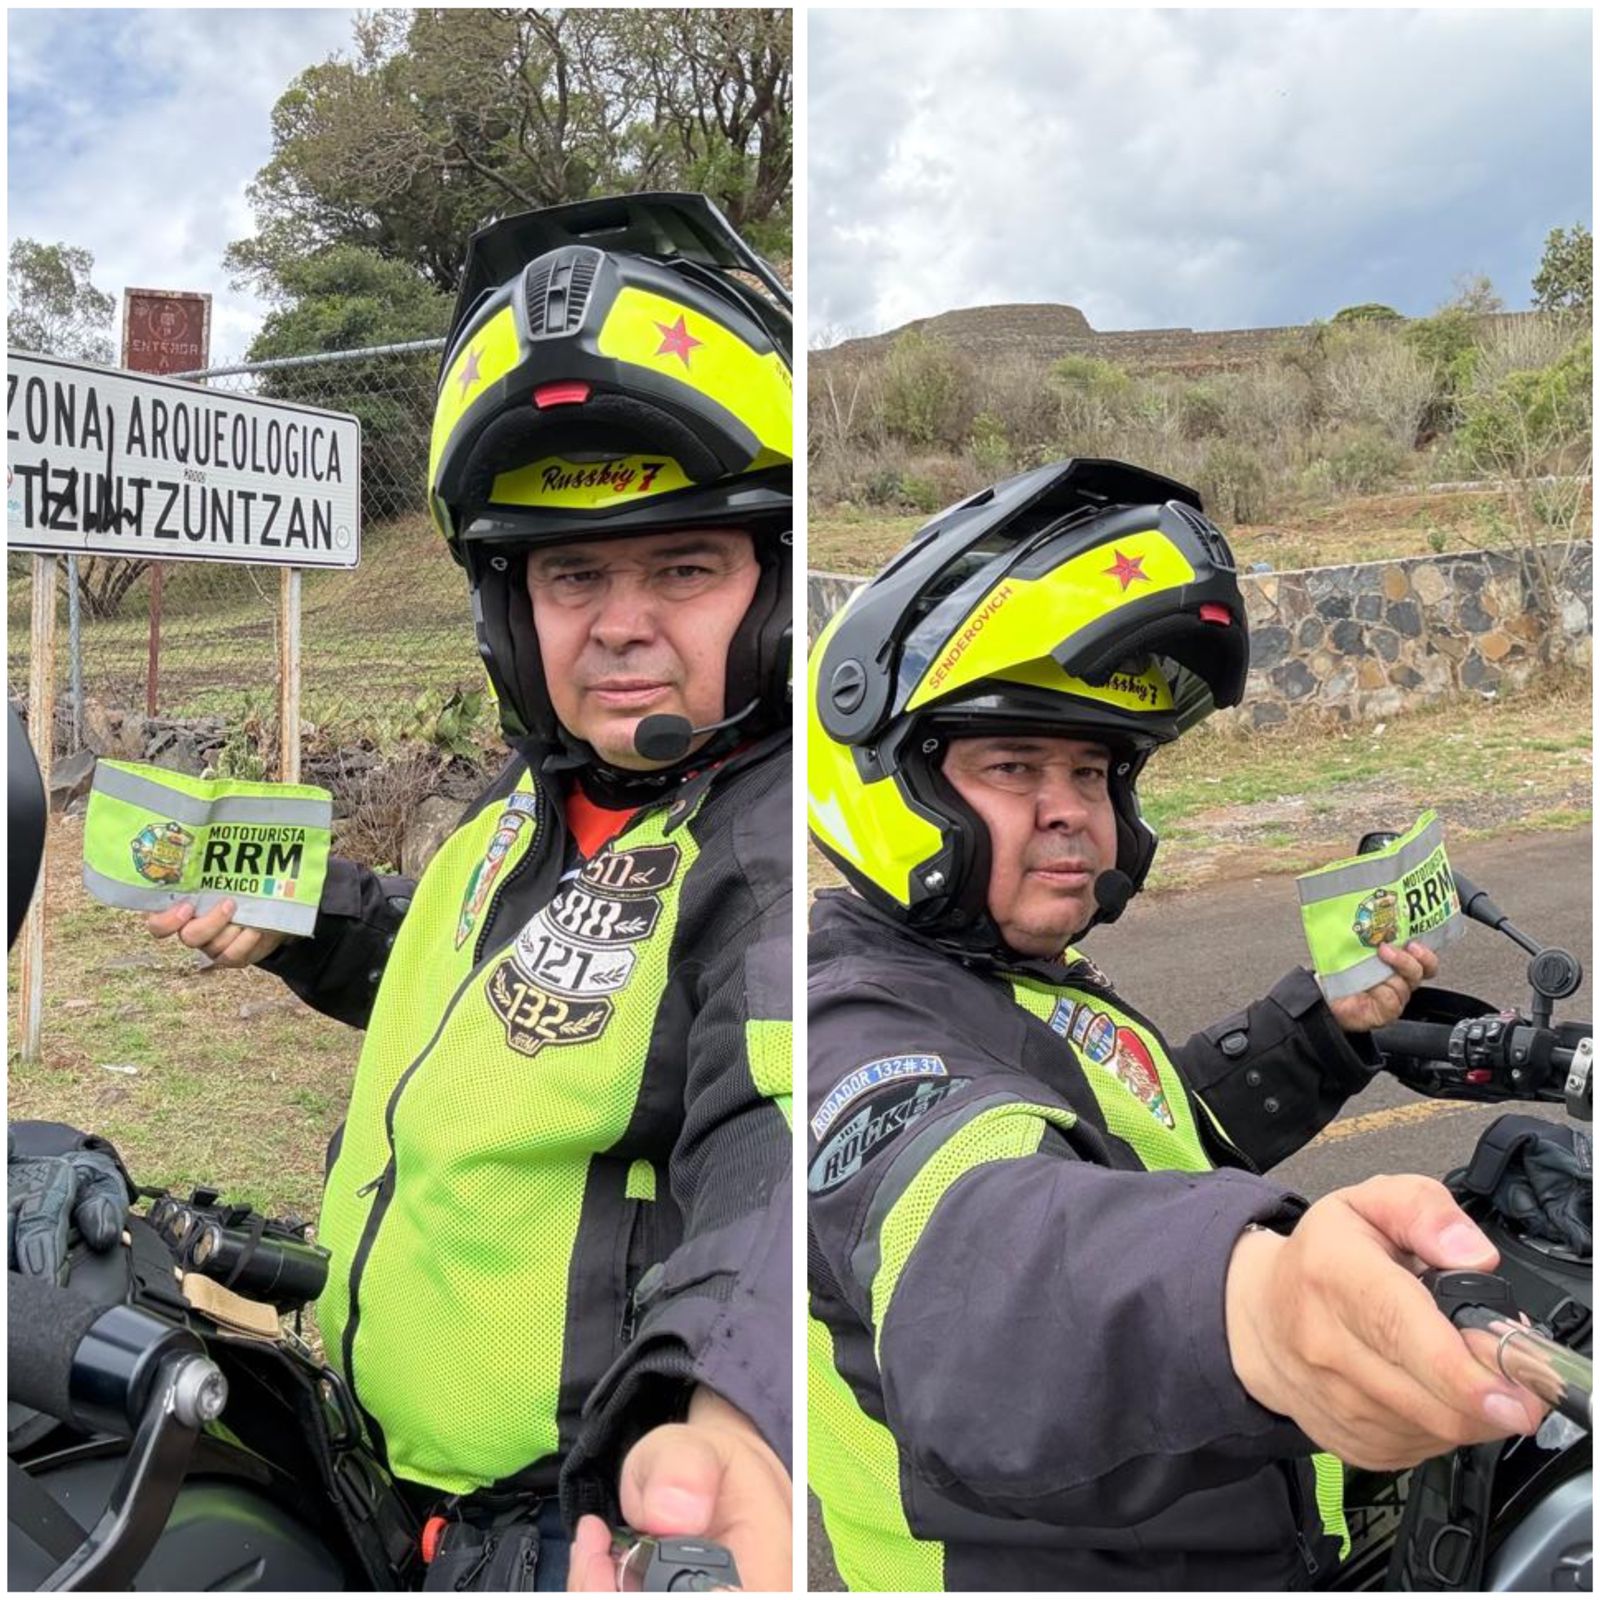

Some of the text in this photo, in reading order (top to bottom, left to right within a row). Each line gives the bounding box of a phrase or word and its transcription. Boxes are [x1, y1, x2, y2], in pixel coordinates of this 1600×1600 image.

[7, 374, 104, 451] ZONA
[126, 395, 342, 483] ARQUEOLOGICA
[542, 463, 666, 493] Russkiy 7
[14, 464, 332, 550] TZINTZUNTZAN
[929, 586, 1013, 690] SENDEROVICH
[203, 841, 304, 879] RRM
[209, 826, 305, 842] MOTOTURISTA
[556, 890, 622, 939] 88
[1406, 862, 1455, 922] RRM
[532, 935, 594, 988] 121
[507, 983, 569, 1039] 132
[815, 1071, 870, 1132] RODADOR
